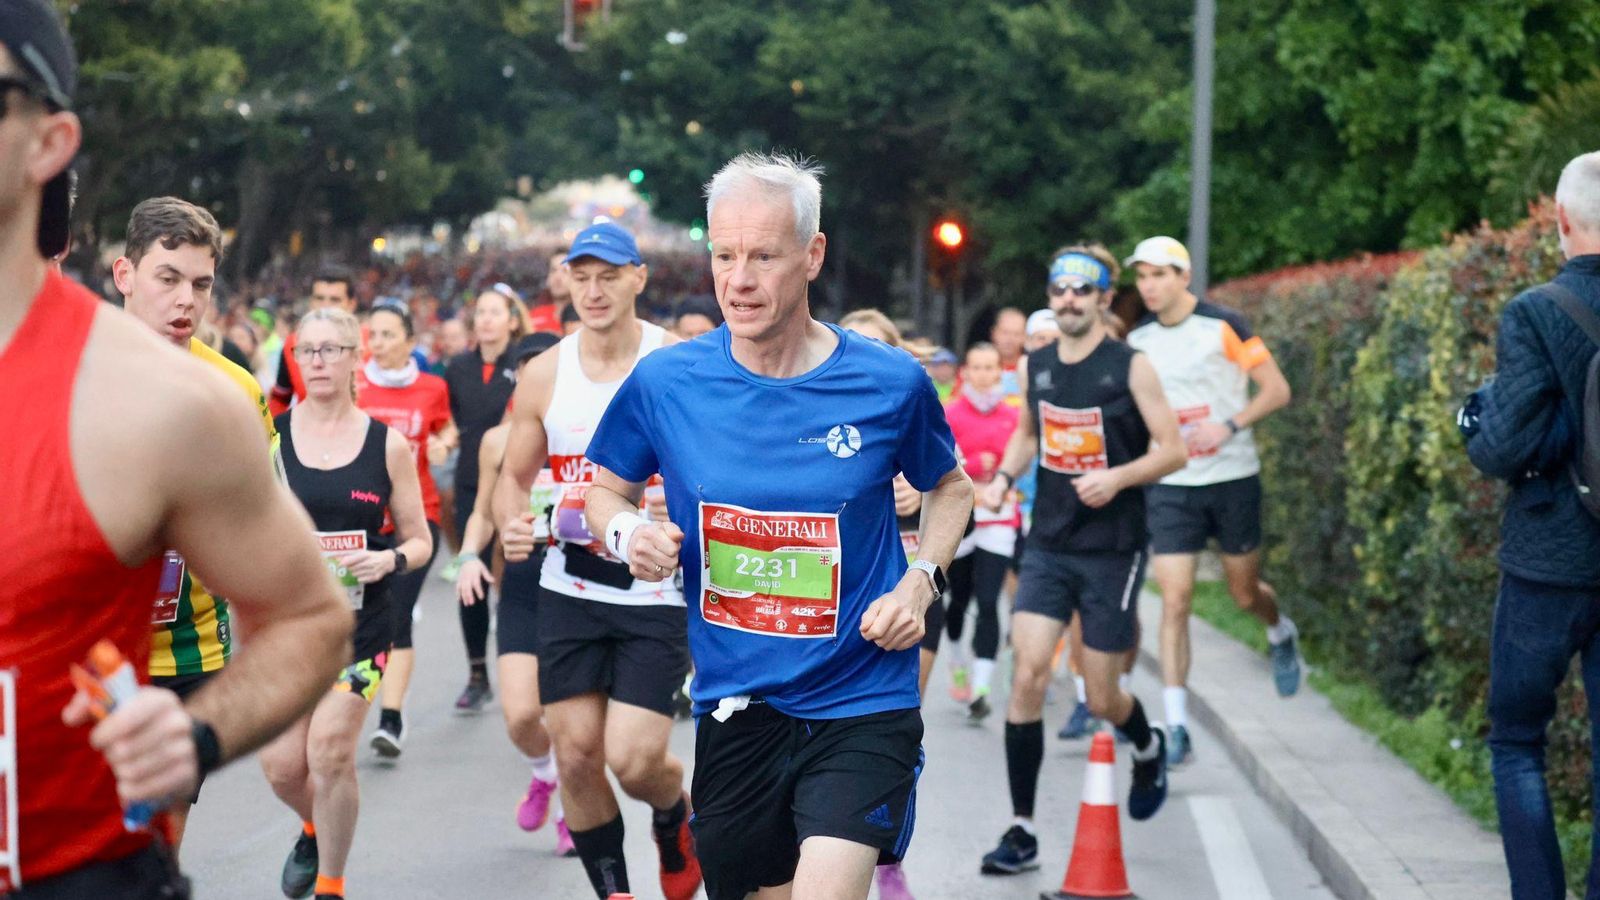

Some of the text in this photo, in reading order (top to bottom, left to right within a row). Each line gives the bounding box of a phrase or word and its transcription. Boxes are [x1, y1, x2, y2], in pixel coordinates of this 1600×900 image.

[736, 516, 827, 539] GENERALI
[735, 553, 798, 579] 2231
[753, 579, 781, 589] DAVID
[790, 606, 817, 617] 42K
